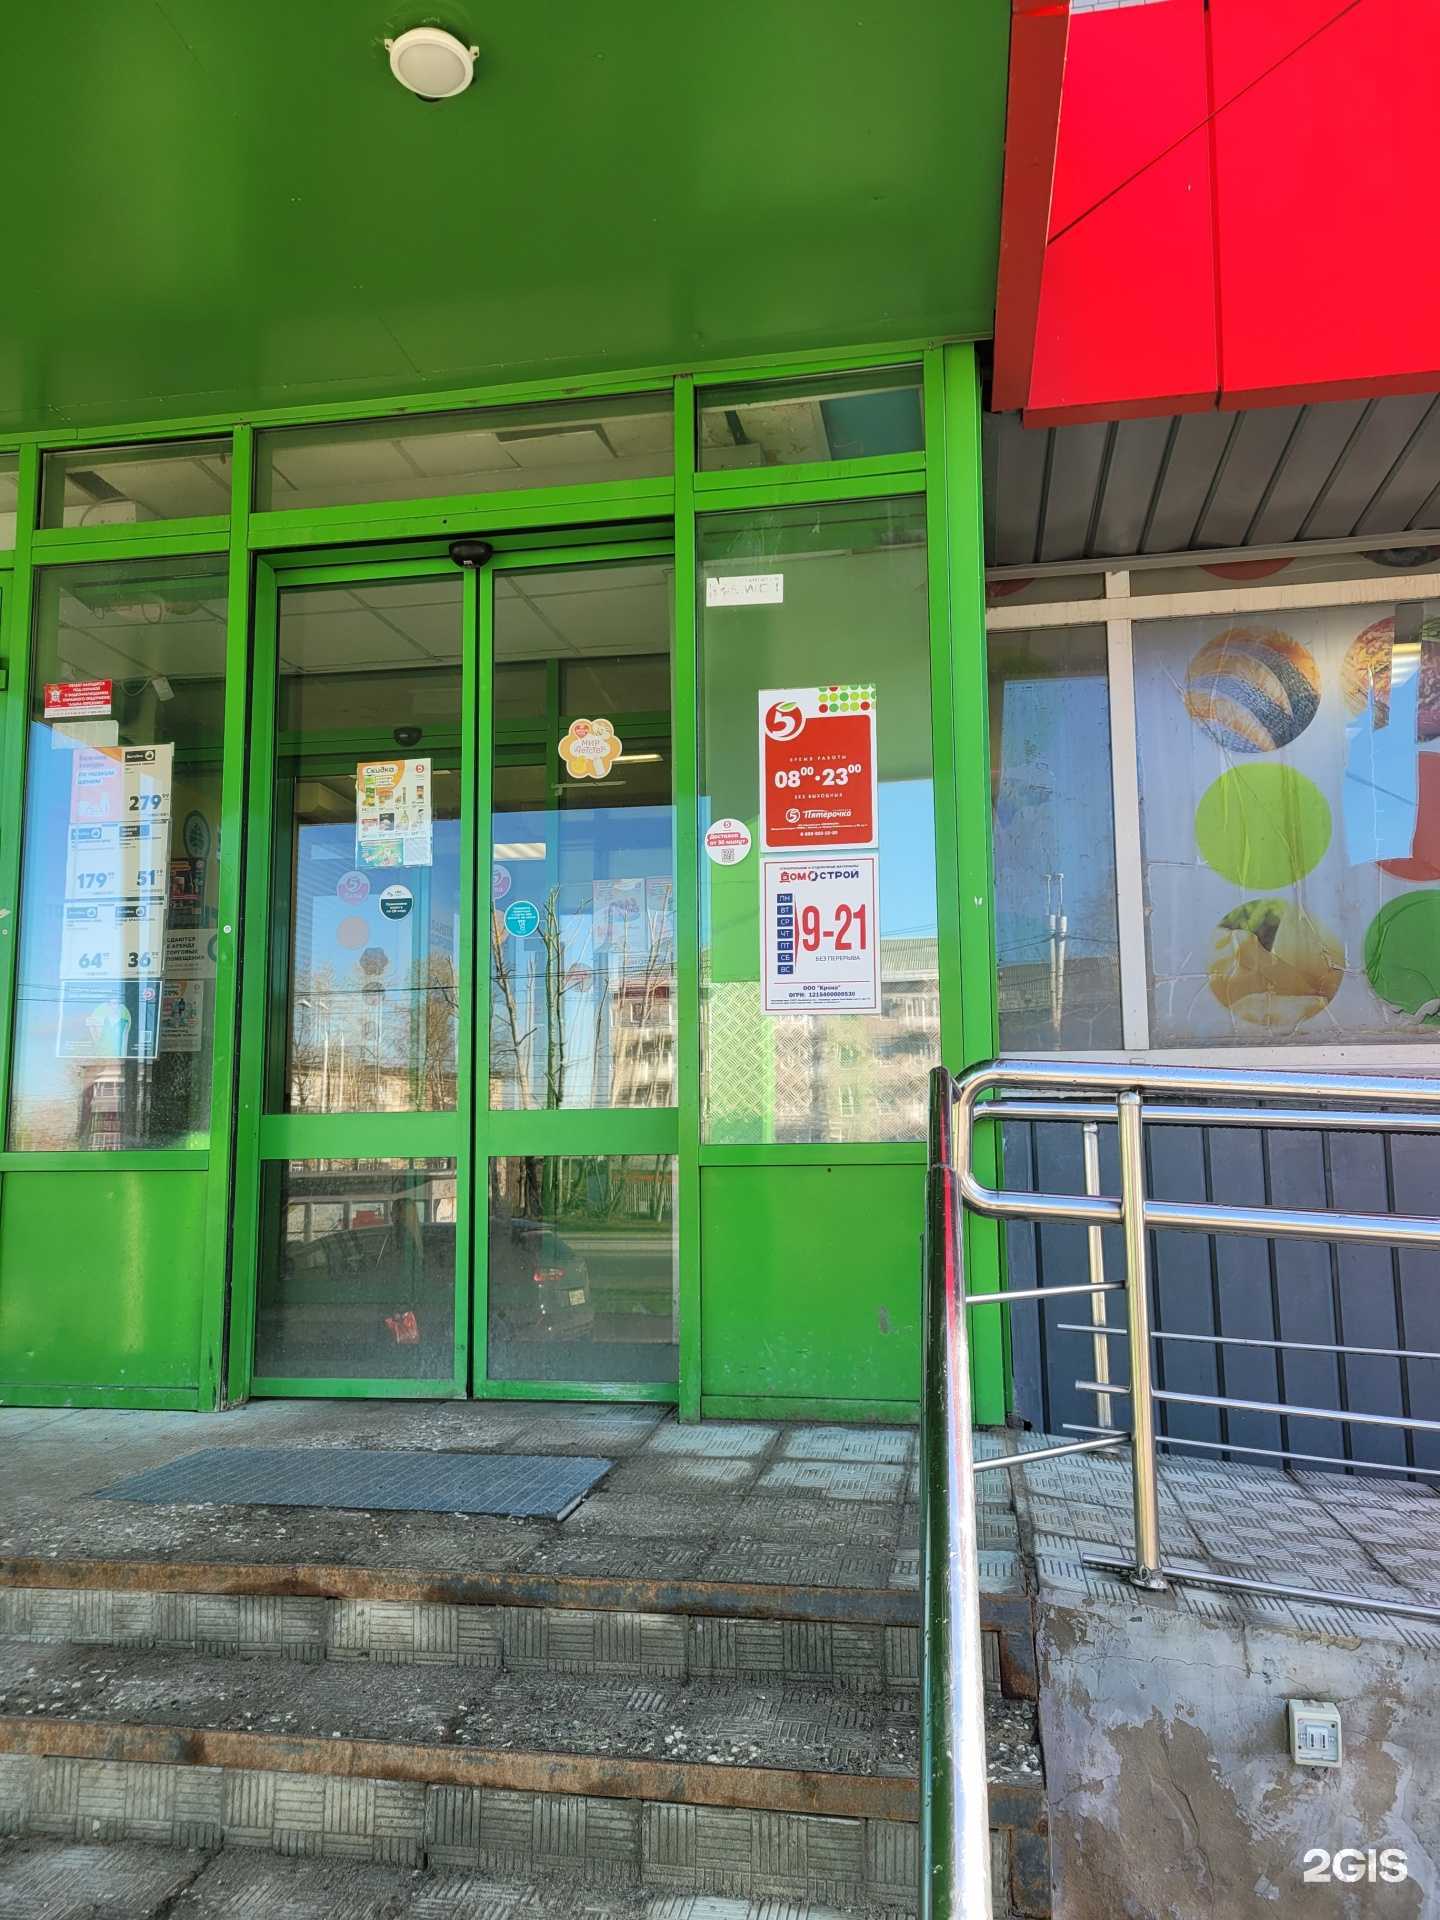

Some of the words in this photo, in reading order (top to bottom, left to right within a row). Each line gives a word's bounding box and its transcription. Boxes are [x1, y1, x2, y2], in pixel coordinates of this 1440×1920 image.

[366, 766, 395, 774] Скидка
[129, 794, 161, 811] 279
[78, 872, 108, 889] 179
[136, 870, 156, 886] 51
[802, 903, 866, 951] 9-21
[78, 952, 103, 969] 64
[127, 951, 151, 968] 36
